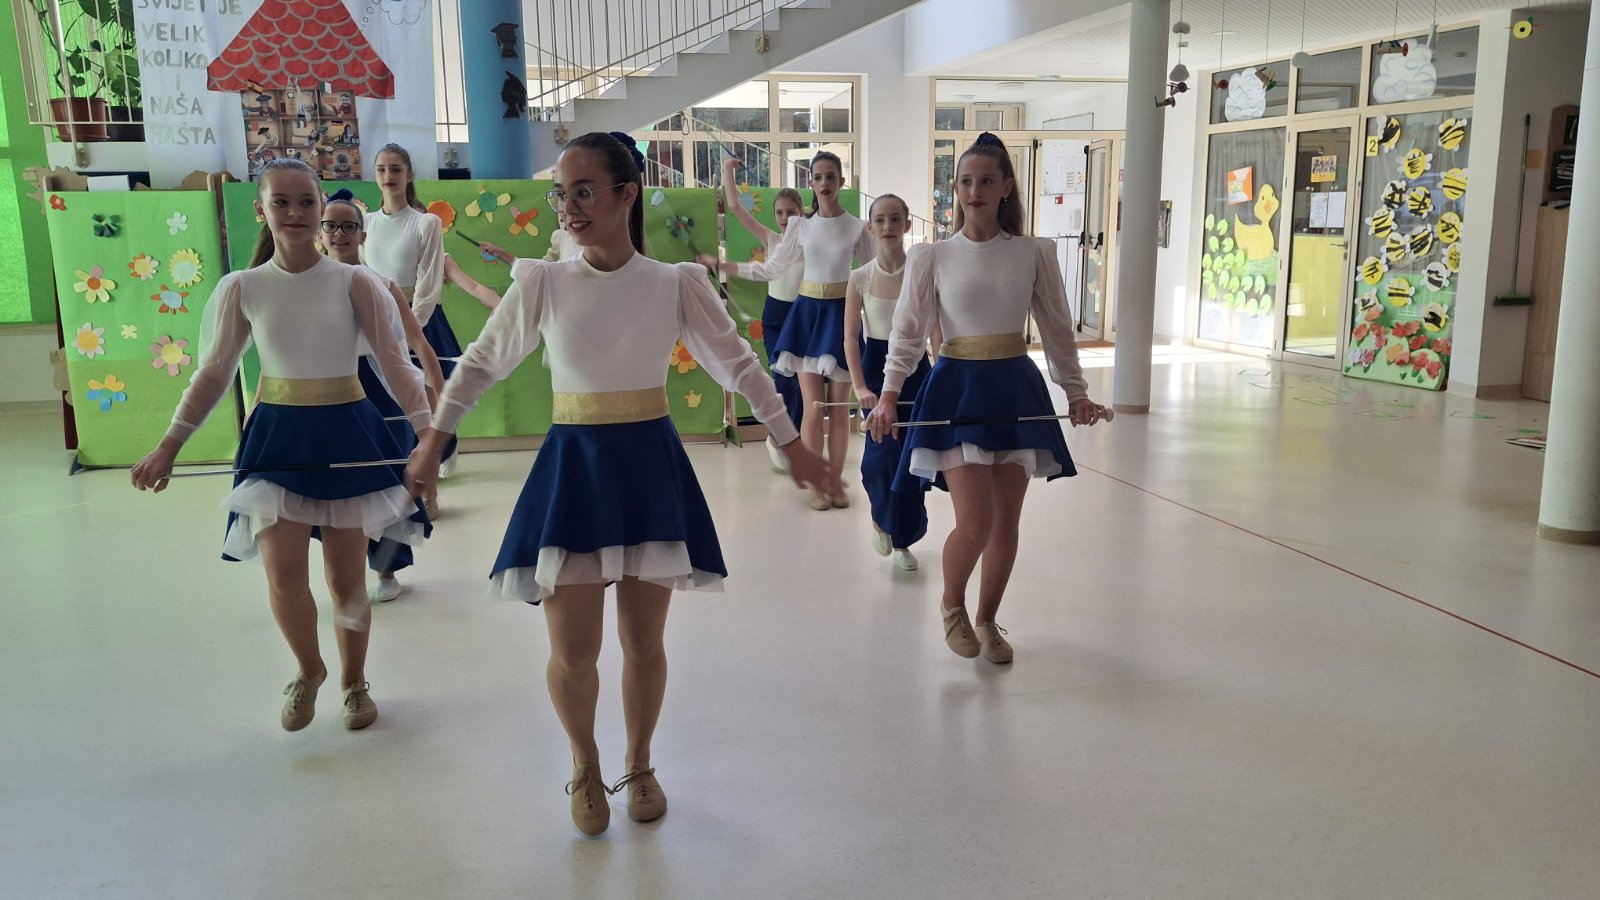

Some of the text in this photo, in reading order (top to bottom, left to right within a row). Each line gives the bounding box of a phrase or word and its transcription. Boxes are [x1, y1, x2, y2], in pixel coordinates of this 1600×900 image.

[141, 23, 206, 42] VELIK
[143, 49, 208, 69] KOLIKO
[150, 91, 203, 115] NAŠA
[150, 121, 216, 145] MAŠTA
[1369, 139, 1376, 153] 2
